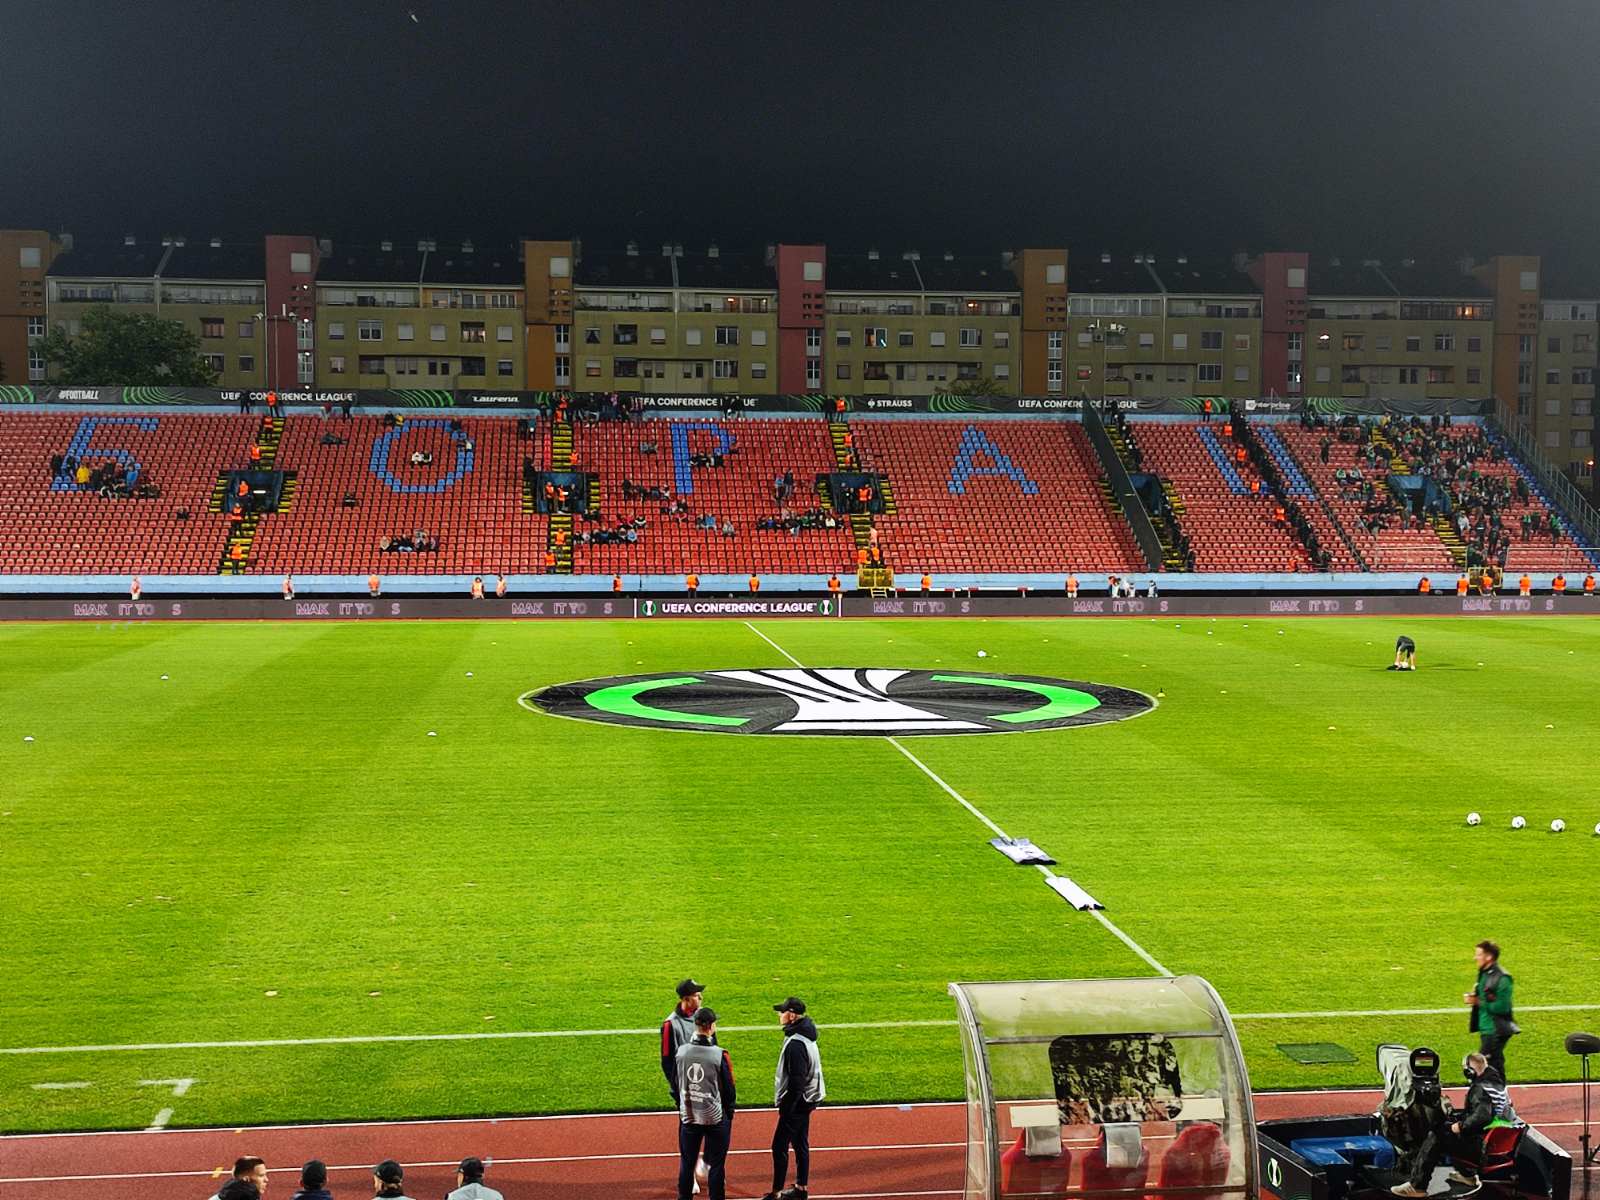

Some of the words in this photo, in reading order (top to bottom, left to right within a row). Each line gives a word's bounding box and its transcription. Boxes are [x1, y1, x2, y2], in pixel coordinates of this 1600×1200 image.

[220, 391, 245, 400] UEF
[315, 392, 353, 401] LEAGUE
[656, 397, 718, 407] CONFERENCE
[876, 399, 913, 408] STRAUSS
[1018, 400, 1042, 408] UEFA
[1043, 400, 1102, 409] CONFERECE
[661, 602, 693, 613] UEFA
[695, 602, 768, 613] CONFERENCE
[770, 602, 815, 613] LEAGUE
